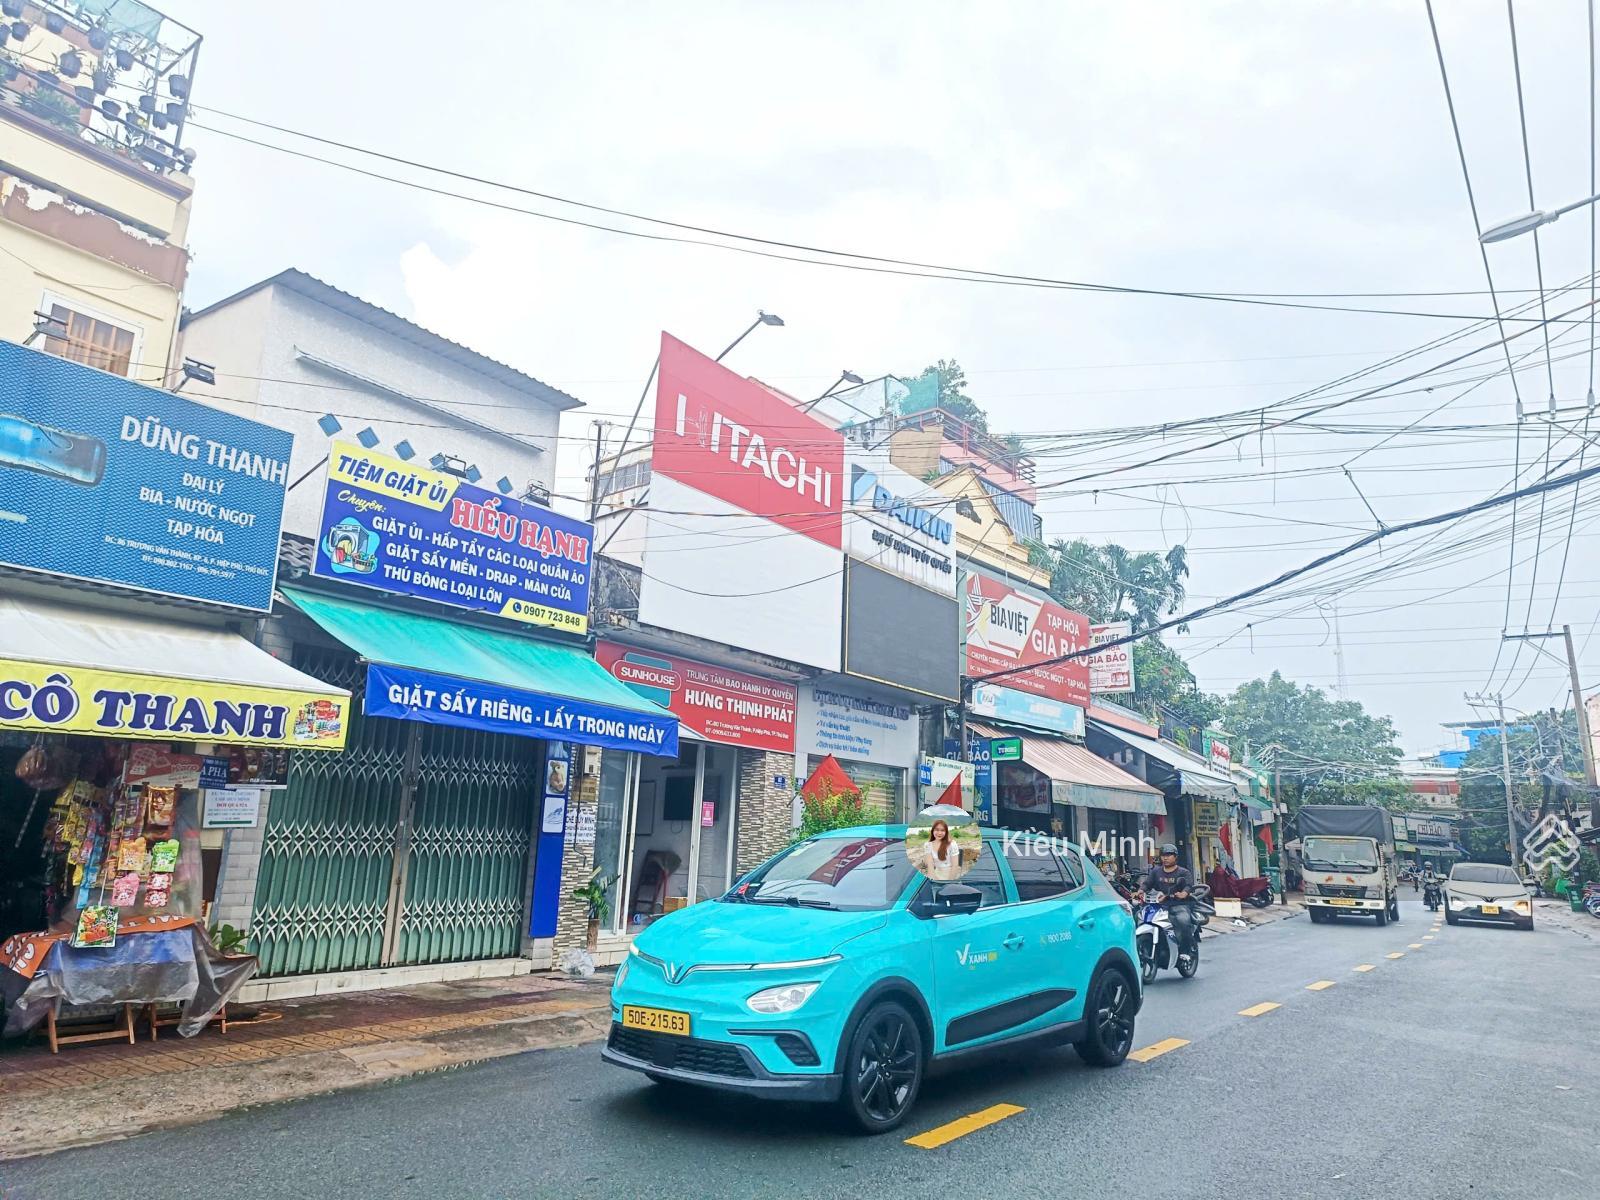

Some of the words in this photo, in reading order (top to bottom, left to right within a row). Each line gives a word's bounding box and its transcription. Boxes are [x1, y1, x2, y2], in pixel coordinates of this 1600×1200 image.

[120, 415, 200, 460] DŨNG
[206, 440, 288, 486] THANH
[182, 472, 206, 492] ĐẠI
[209, 479, 224, 495] LÝ
[338, 455, 384, 482] TIỆM
[385, 471, 428, 497] GIẶT
[429, 480, 448, 503] ỦI
[139, 486, 163, 505] BIA
[175, 495, 217, 518] NƯỚC
[219, 507, 256, 528] NGỌT
[166, 519, 193, 538] TẠP
[195, 525, 224, 544] HÓA
[520, 519, 589, 564] HẠNH
[372, 516, 407, 537] GIẶT
[409, 522, 423, 540] ỦI
[432, 531, 458, 549] HẤP
[460, 538, 485, 557] TẨY
[486, 548, 511, 565] CÁC
[512, 555, 538, 574] LOẠI
[571, 569, 585, 585] ÁO
[383, 564, 411, 583] THÚ
[412, 571, 448, 592] BÔNG
[450, 580, 478, 600] LOẠI
[480, 587, 502, 604] LỚN
[386, 542, 420, 563] GIẶT
[421, 550, 448, 569] SẤY
[450, 557, 478, 577] MỀN
[485, 568, 518, 586] DRAP
[524, 578, 549, 595] MÀN
[550, 583, 572, 601] CỬA
[523, 605, 546, 619] 0907
[547, 609, 563, 623] 723
[564, 613, 581, 627] 848
[1047, 613, 1062, 631] TẠP
[1063, 619, 1080, 637] HÓA
[1031, 629, 1057, 657] GIA
[1105, 652, 1127, 663] BẢO
[620, 666, 676, 686] SUNHOUSE
[686, 669, 709, 682] TRUNG
[741, 680, 761, 694] HÀNH
[0, 672, 79, 724] CÔ
[93, 689, 289, 739] THANH
[388, 683, 436, 712] GIẶT
[440, 688, 477, 714] SẤY
[480, 699, 533, 724] RIÊNG
[543, 706, 575, 731] LẤY
[577, 715, 626, 739] TRONG
[627, 719, 665, 745] NGÀY
[684, 688, 723, 710] HƯNG
[726, 697, 763, 720] THỊNH
[763, 703, 794, 723] PHÁT
[968, 953, 988, 964] XANH
